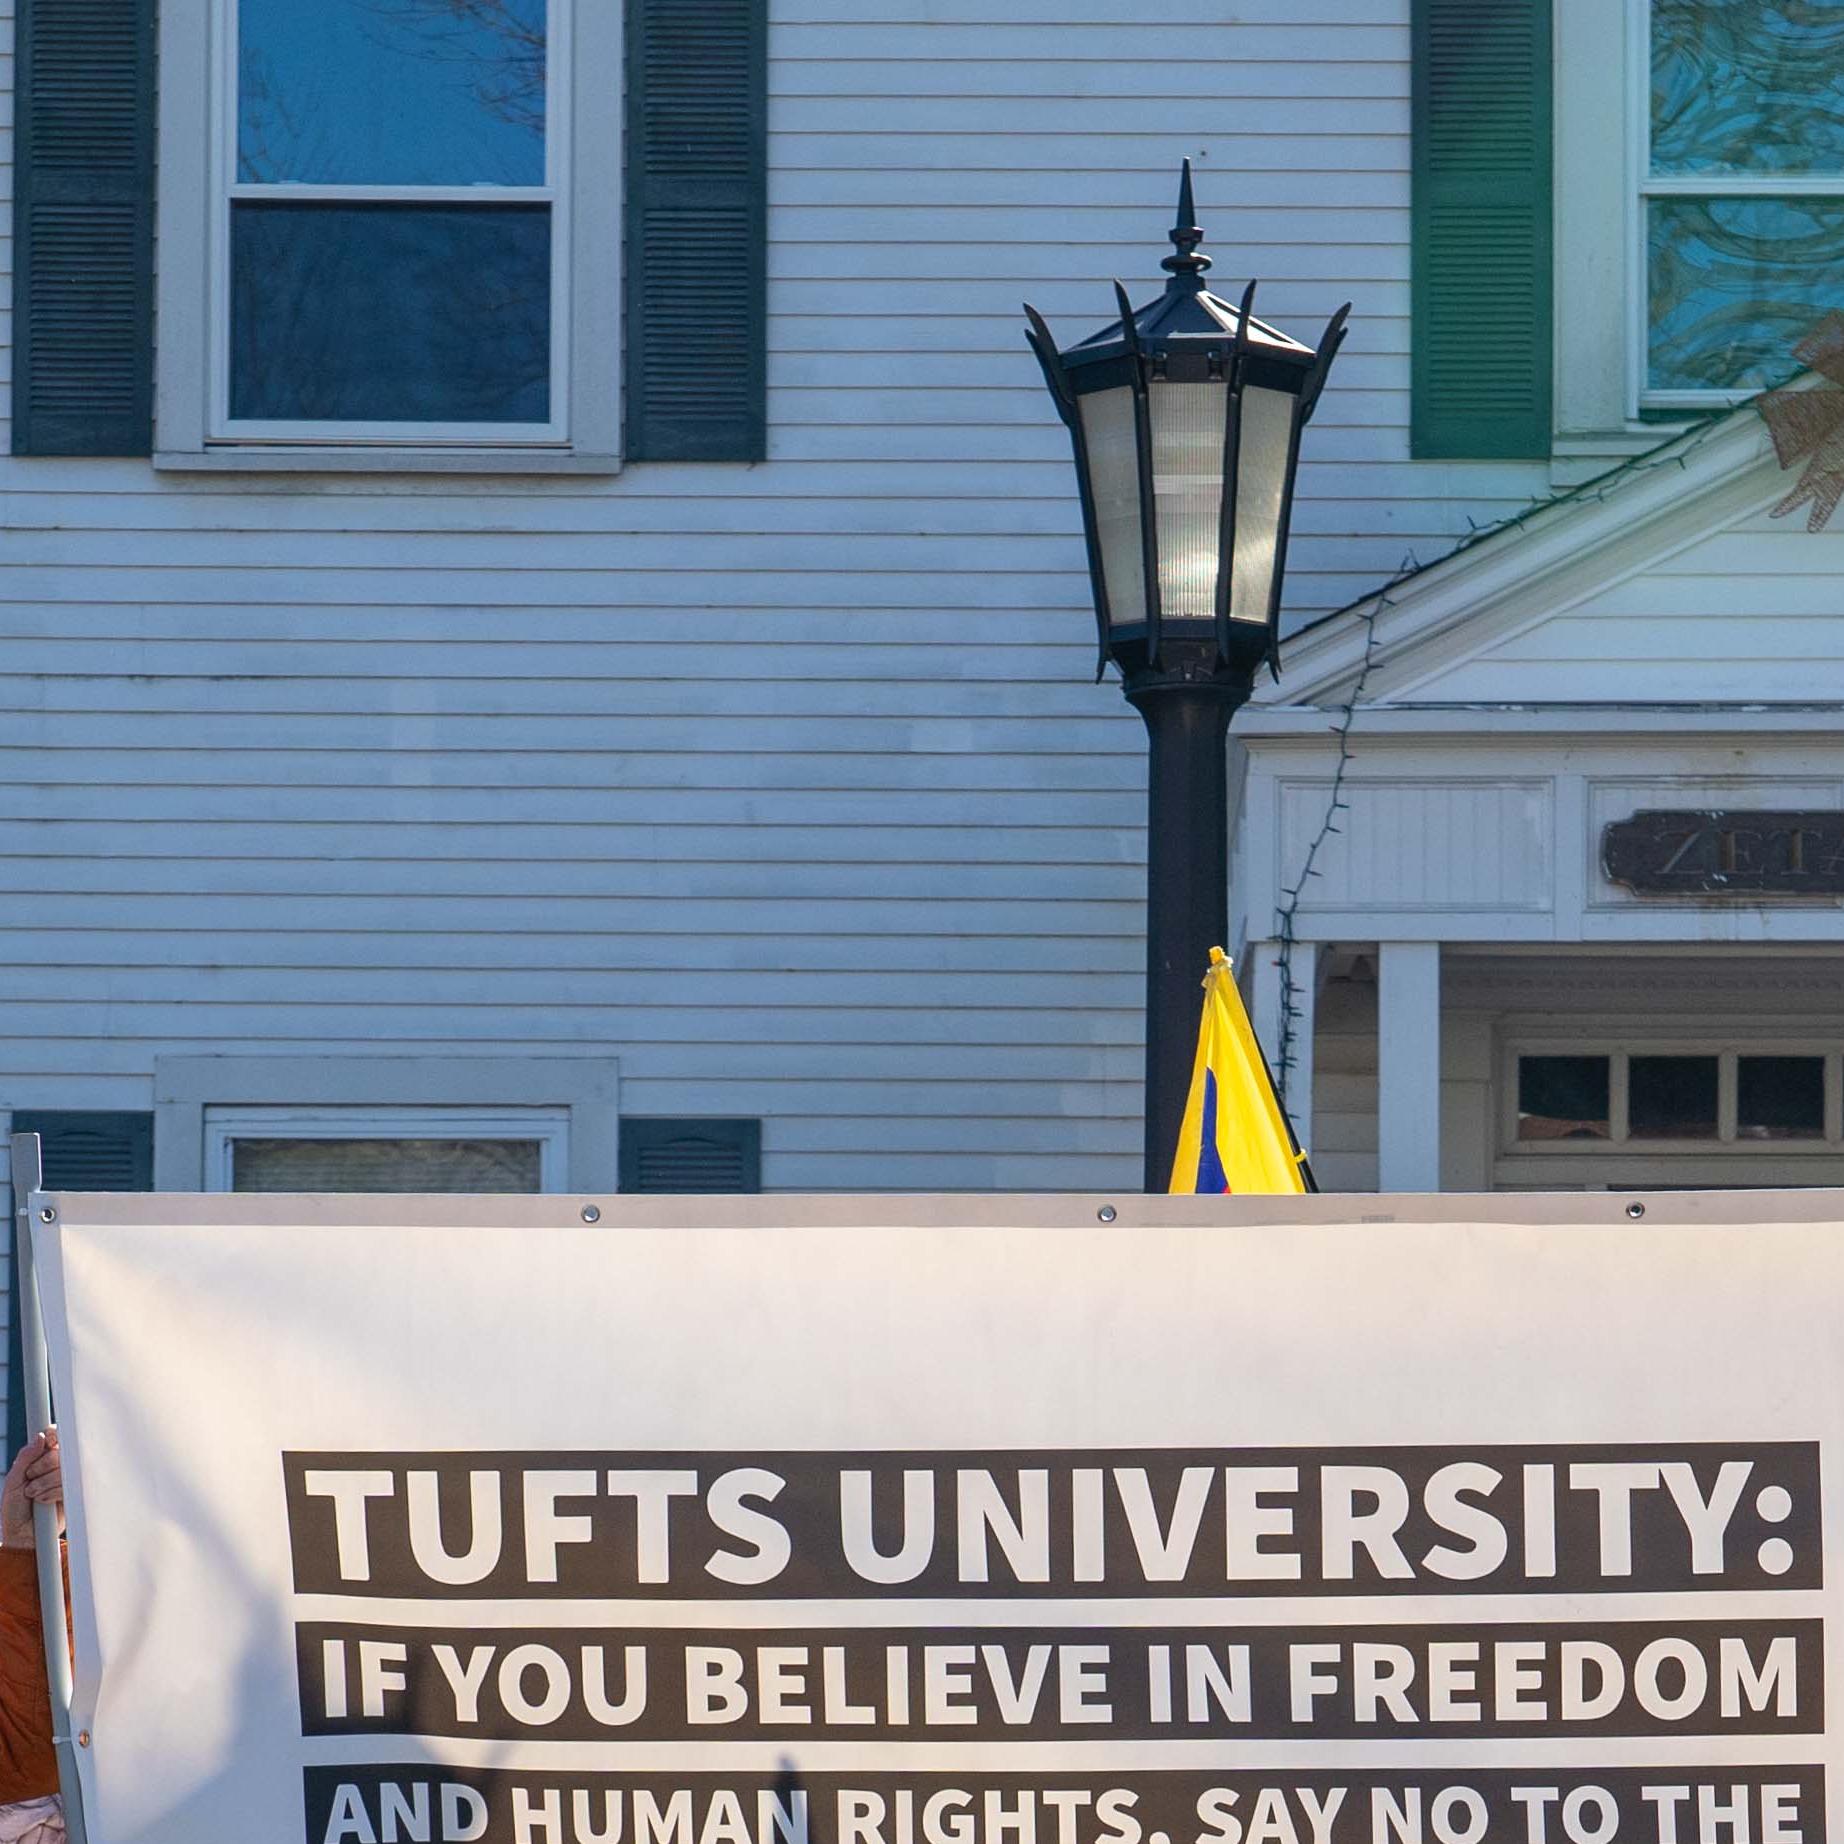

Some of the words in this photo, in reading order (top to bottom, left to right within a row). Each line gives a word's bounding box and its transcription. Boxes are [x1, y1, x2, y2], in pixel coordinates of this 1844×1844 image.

[304, 1468, 792, 1586] TUFTS
[840, 1461, 1794, 1585] UNIVERSITY:
[322, 1639, 408, 1718] IF
[430, 1643, 648, 1727] YOU
[684, 1644, 1113, 1727] BELIEVE
[1148, 1644, 1253, 1724] IN
[1288, 1636, 1798, 1723] FREEDOM
